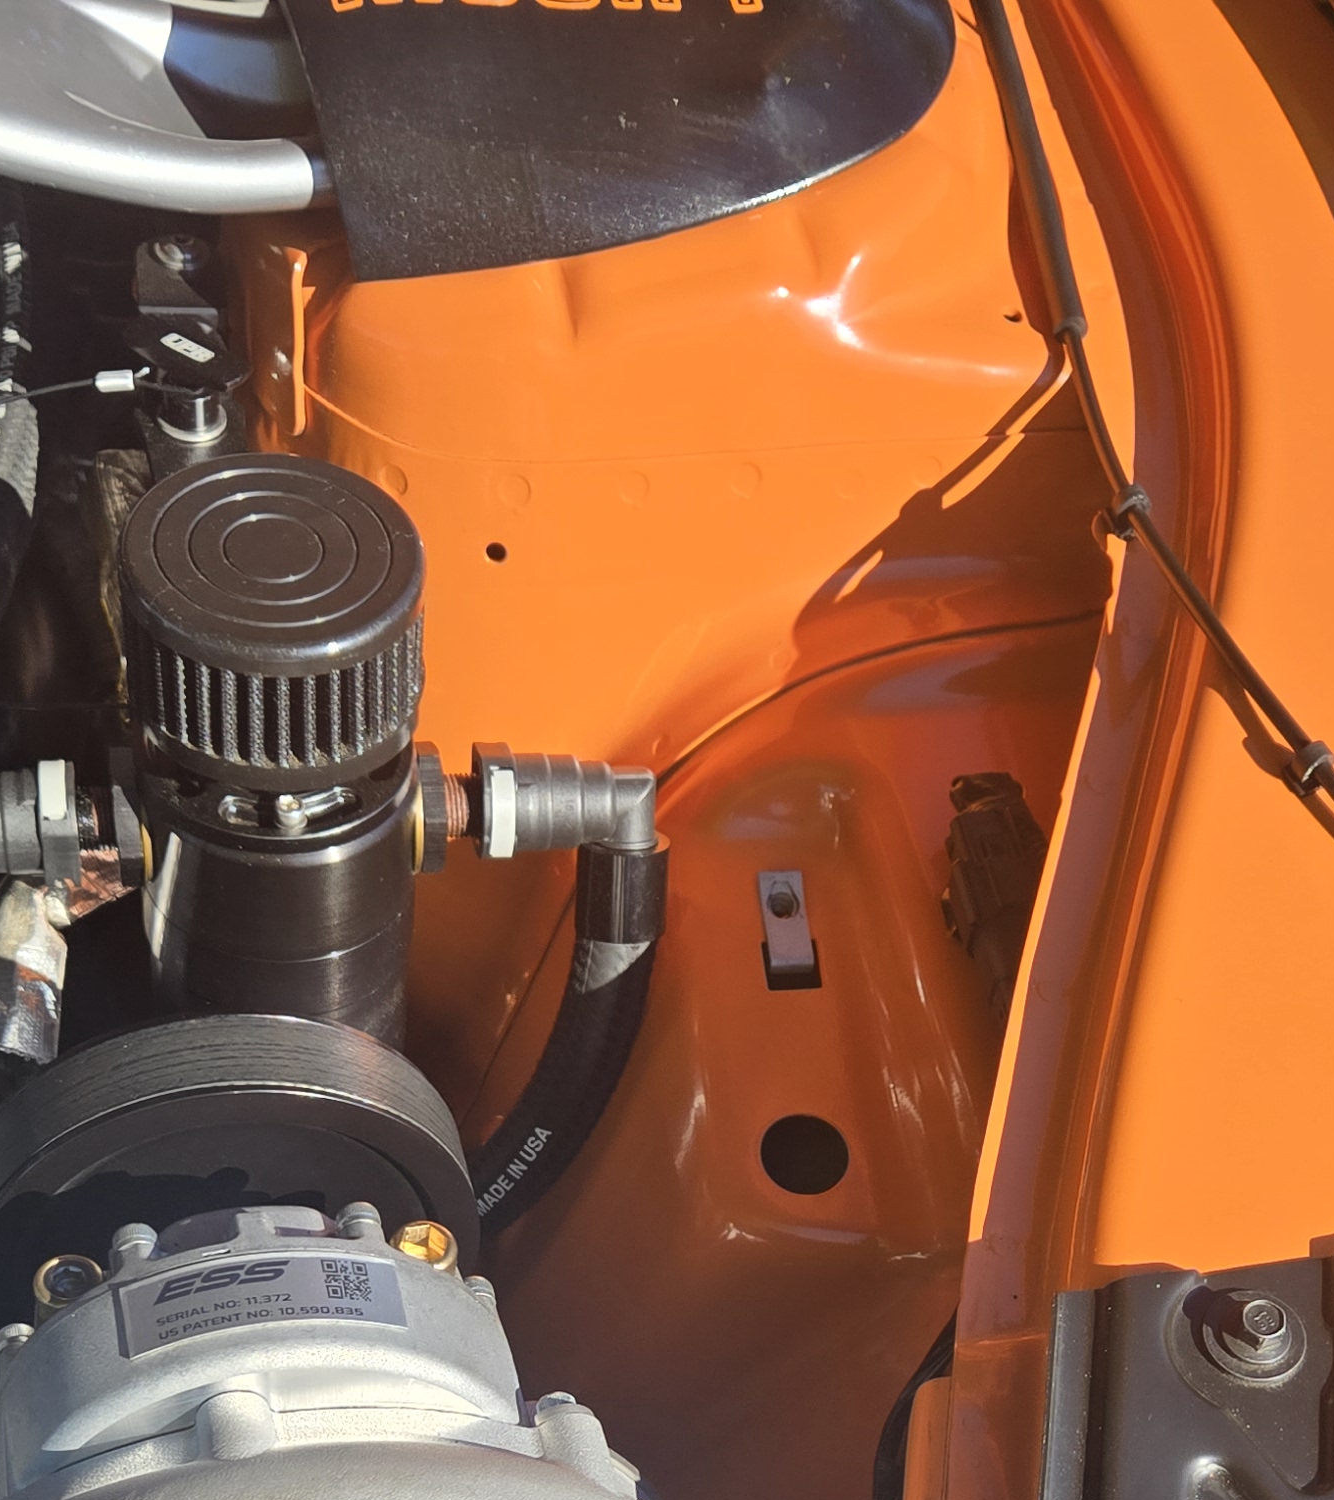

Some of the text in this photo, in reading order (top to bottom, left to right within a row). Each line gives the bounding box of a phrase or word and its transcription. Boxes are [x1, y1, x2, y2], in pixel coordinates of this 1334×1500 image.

[476, 1126, 553, 1217] MADE IN USA
[153, 1260, 291, 1306] ESS
[156, 1306, 210, 1327] SERIAL
[213, 1299, 242, 1312] NO:
[158, 1327, 179, 1340] US
[182, 1312, 242, 1333] PATENT
[246, 1308, 274, 1320] NO:
